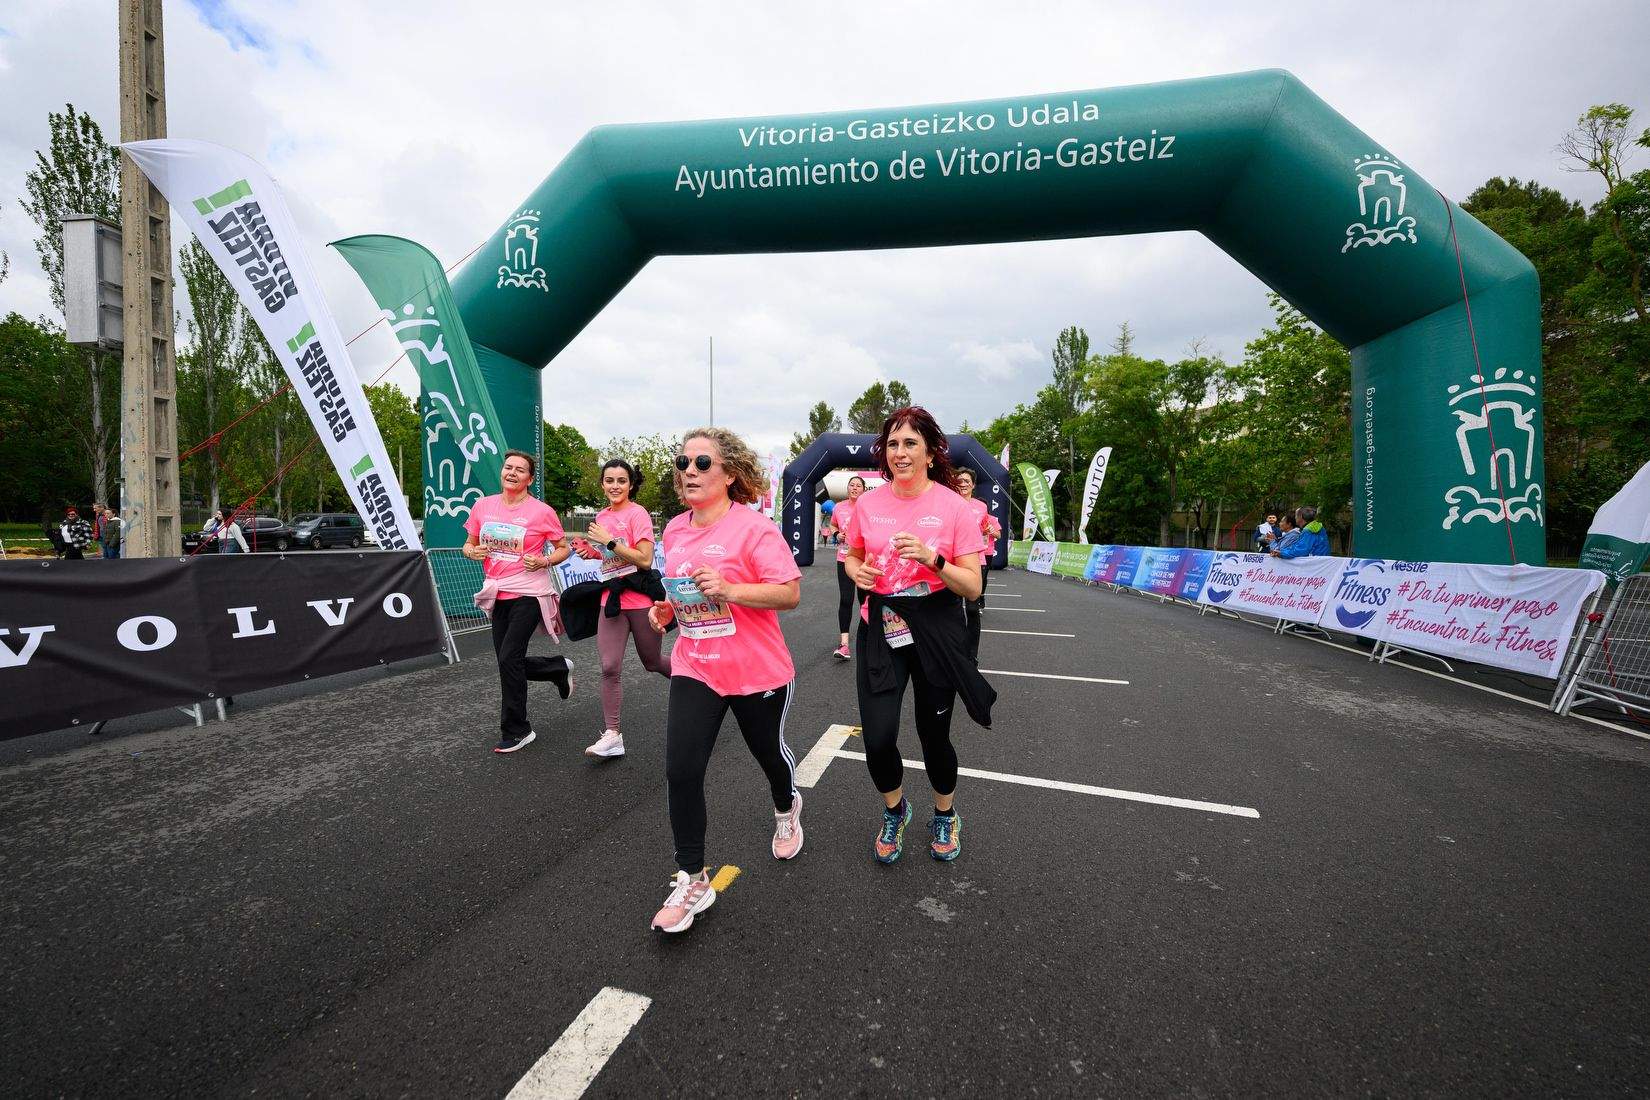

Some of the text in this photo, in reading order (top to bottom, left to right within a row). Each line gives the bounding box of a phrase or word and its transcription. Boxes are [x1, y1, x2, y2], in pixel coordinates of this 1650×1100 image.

[738, 100, 1100, 147] Vitoria-Gasteizko Udala
[674, 129, 1176, 198] Ayuntamiento de Vitoria-Gasteiz
[1365, 386, 1375, 532] www.vitoria-gasteiz.org
[1086, 454, 1106, 518] AMUTIO
[793, 484, 802, 556] VOLVO
[1207, 563, 1243, 587] Fitness
[1239, 587, 1285, 606] #Encuentra
[1272, 573, 1307, 589] primer
[1303, 576, 1327, 592] paso
[1334, 570, 1391, 607] Fitness
[1434, 582, 1452, 603] tu
[1445, 590, 1512, 615] primer
[1503, 598, 1560, 622] paso
[0, 592, 413, 669] VOLVO
[1386, 608, 1470, 641] #Encuentra
[1470, 618, 1491, 645] tu
